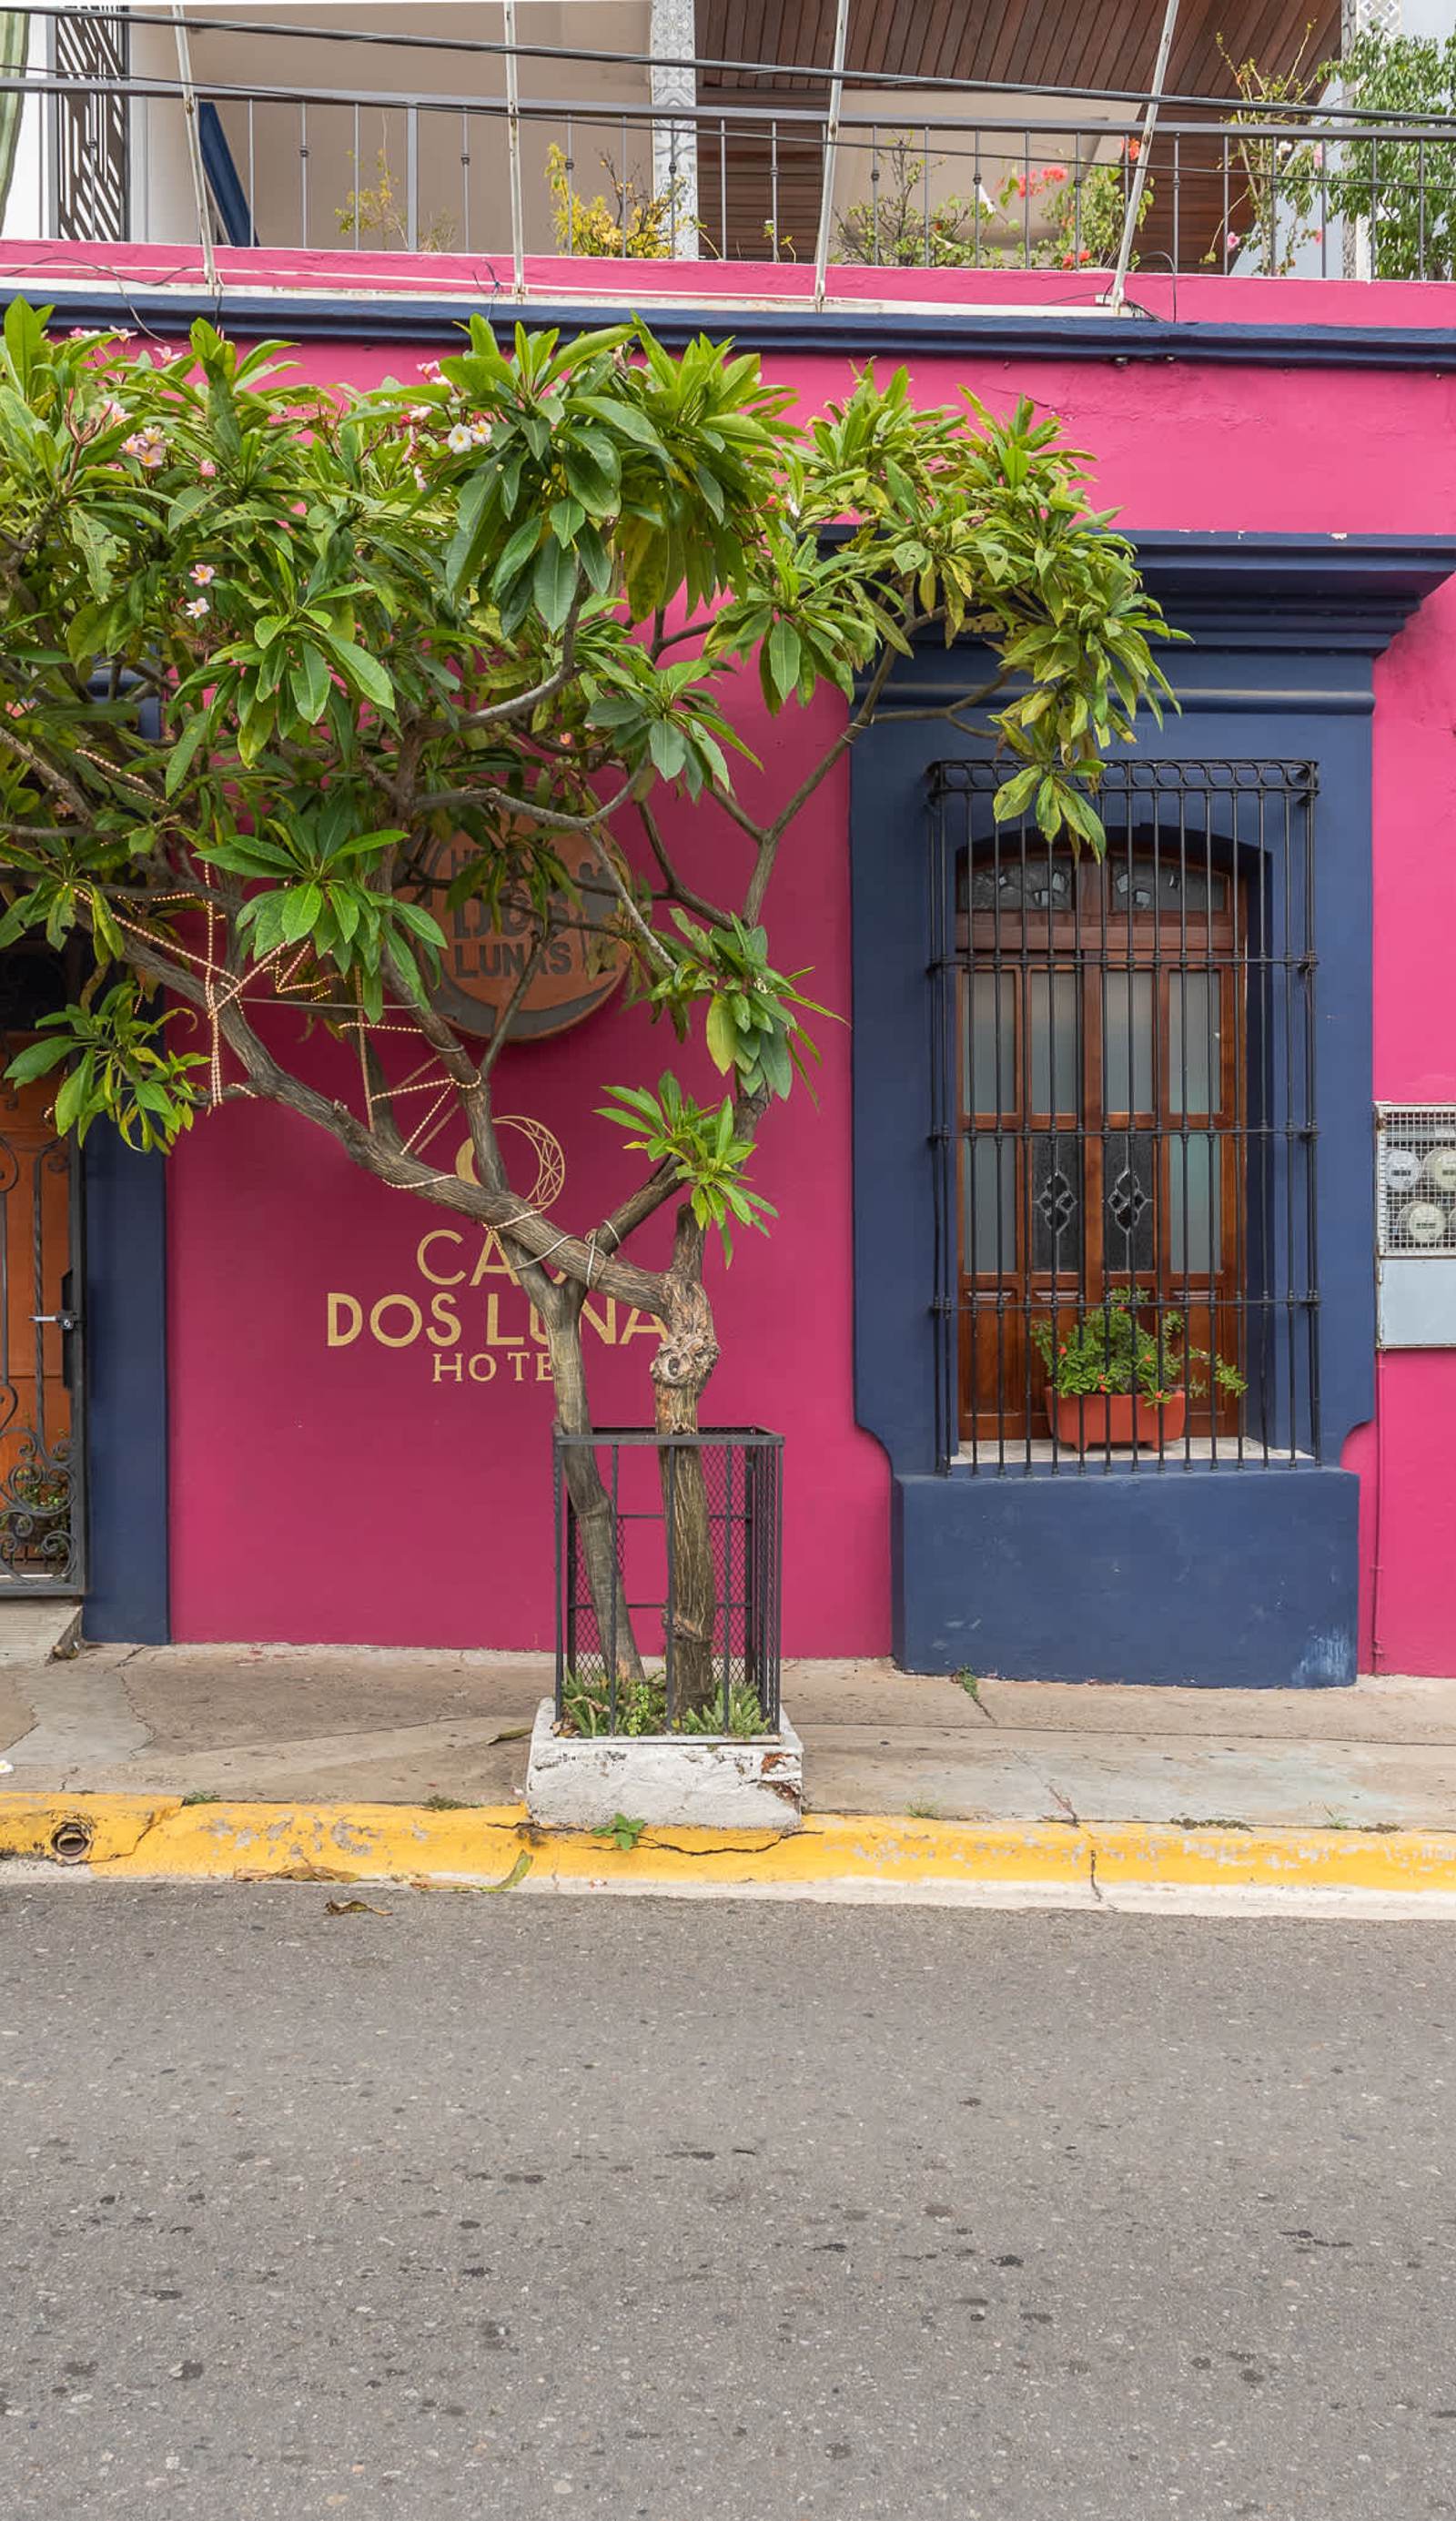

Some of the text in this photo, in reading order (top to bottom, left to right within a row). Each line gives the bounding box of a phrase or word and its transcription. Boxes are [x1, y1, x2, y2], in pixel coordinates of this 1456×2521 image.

[417, 1230, 568, 1286] CA
[327, 1292, 669, 1348] DOS LUNA
[432, 1352, 554, 1382] HOTE
